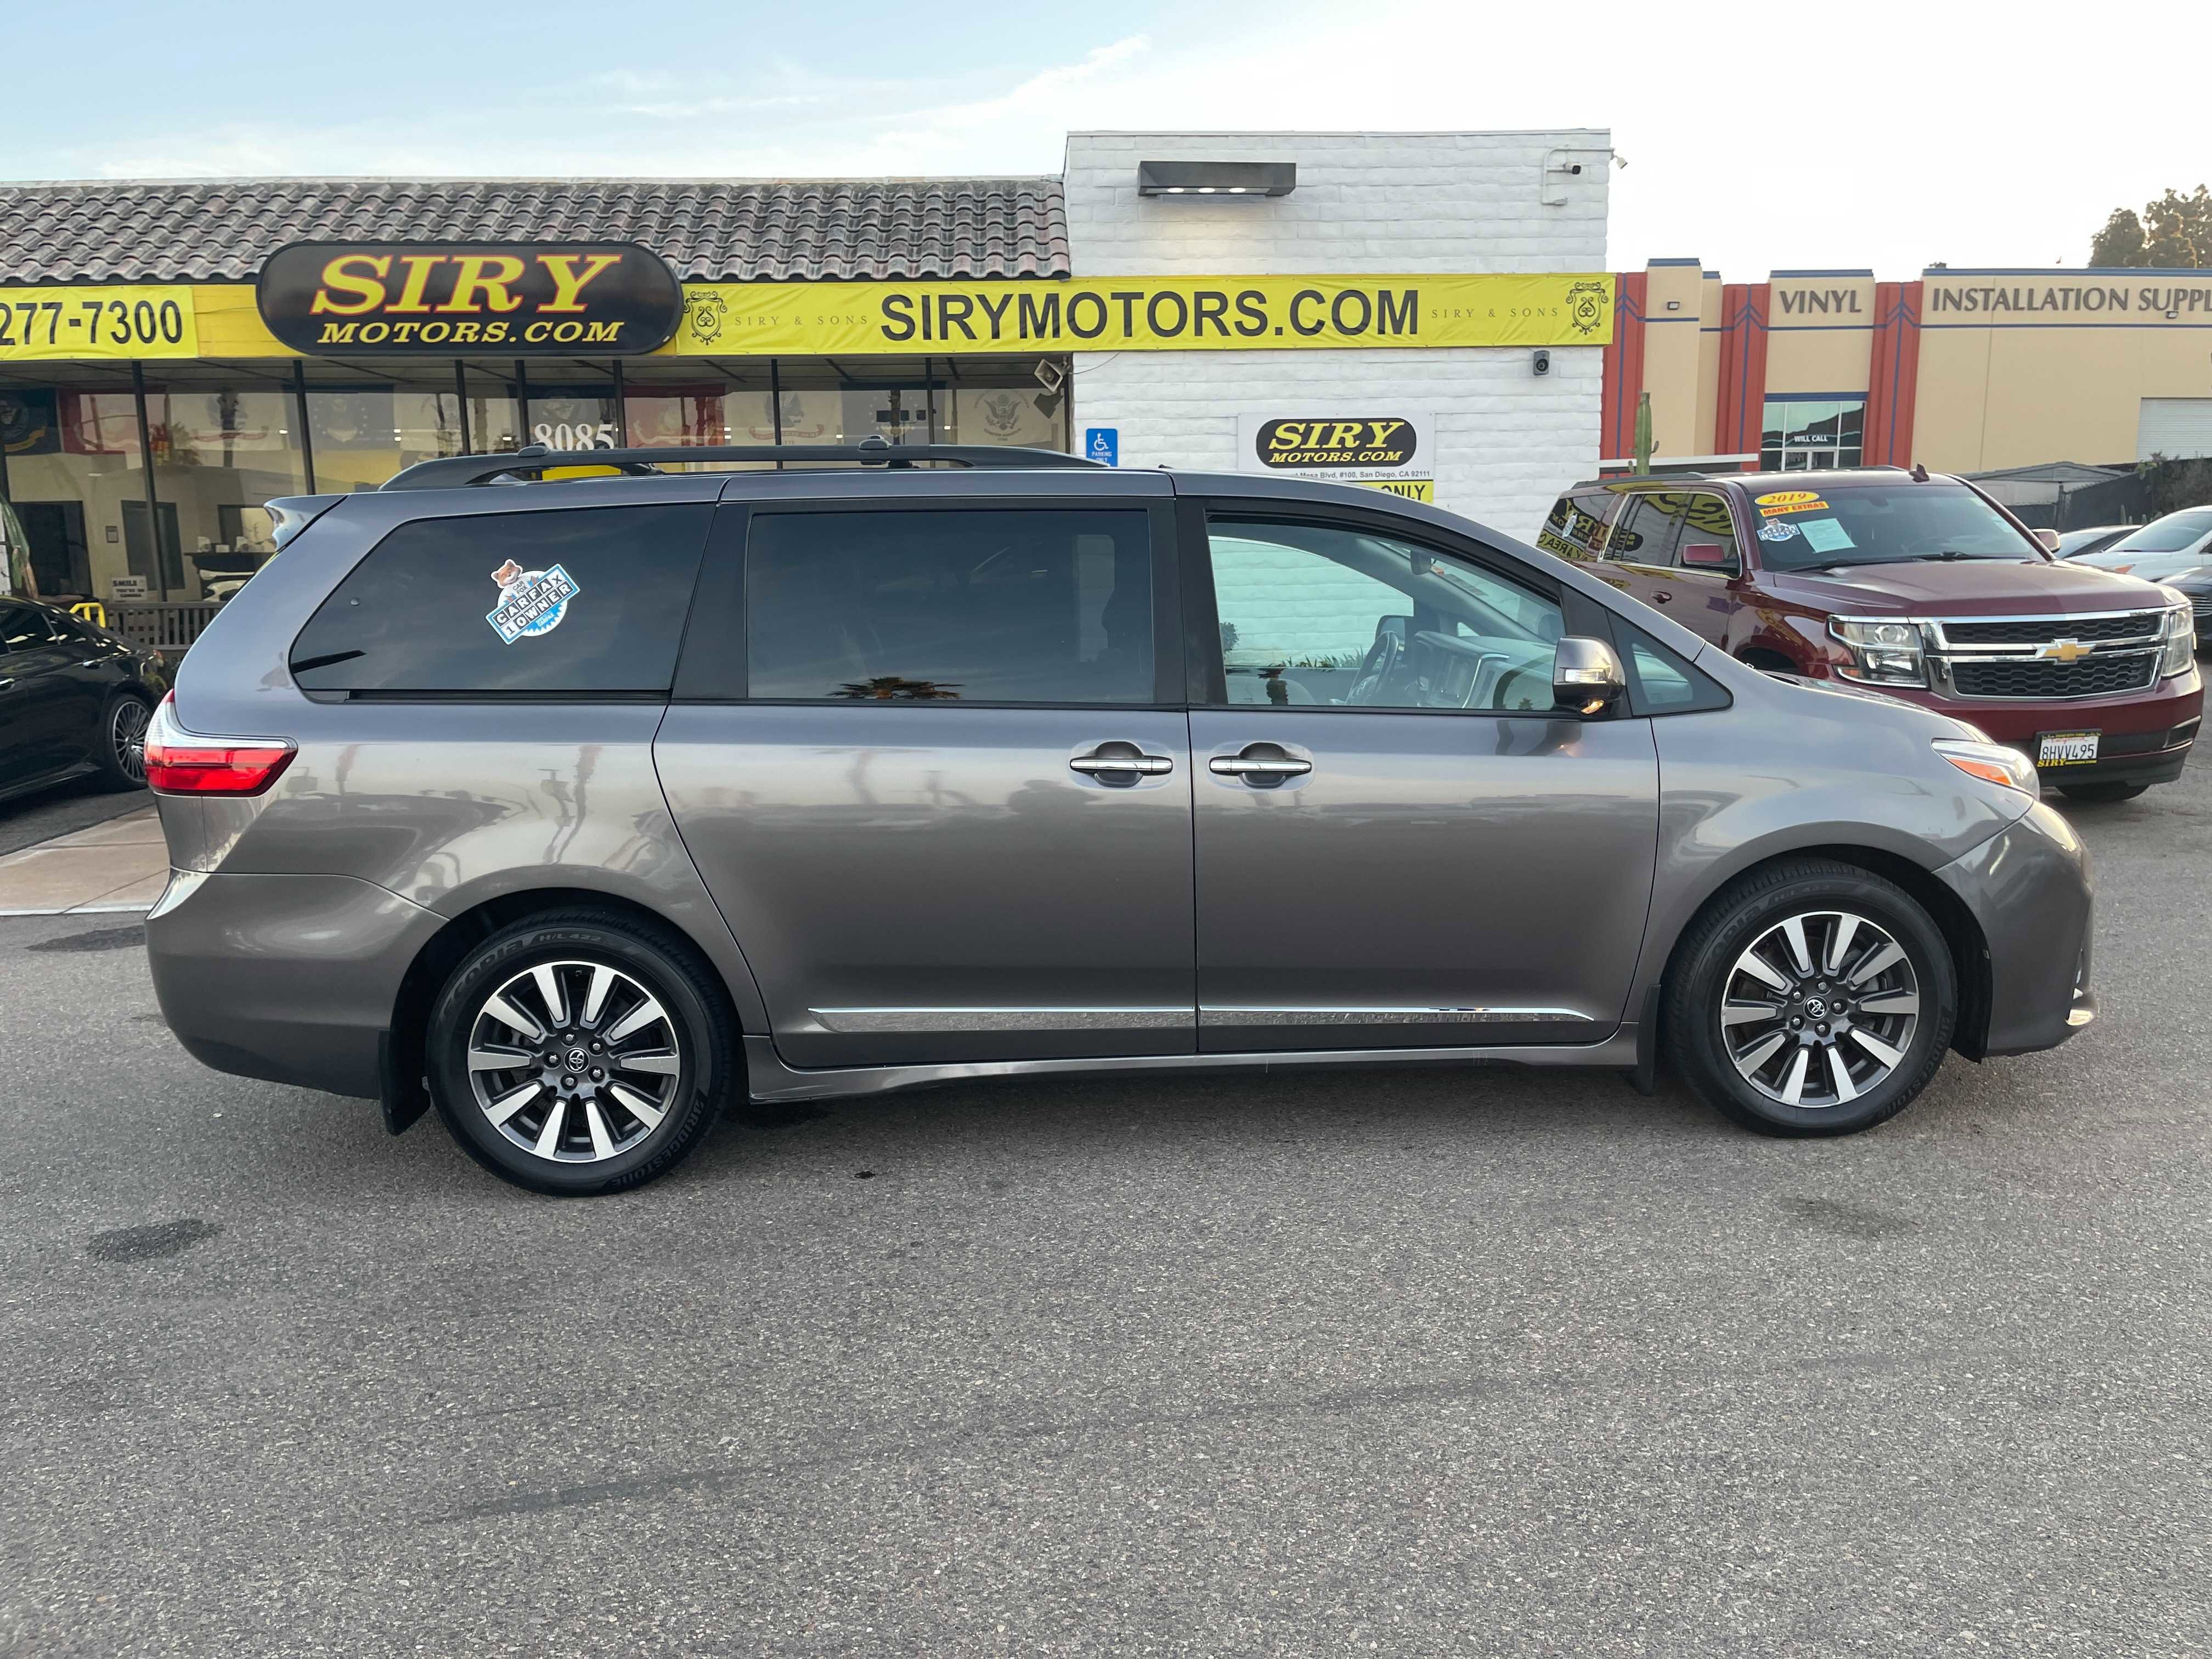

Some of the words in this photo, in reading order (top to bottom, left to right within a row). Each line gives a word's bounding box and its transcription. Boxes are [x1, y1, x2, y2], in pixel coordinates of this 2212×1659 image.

[309, 254, 623, 315] SIRY
[1779, 290, 1862, 313] VINYL
[1932, 288, 2129, 311] INSTALLATION
[2138, 288, 2212, 312] SUPPL
[735, 316, 779, 325] SIRY
[795, 316, 802, 325] &
[817, 315, 867, 325] SONS
[880, 289, 1418, 341] SIRYMOTORS.COM
[1431, 309, 1474, 318] SIRY
[1488, 308, 1496, 317] &
[1510, 308, 1558, 317] SONS
[0, 300, 182, 346] 277-7300
[317, 321, 624, 343] MOTORS.COM
[533, 424, 614, 451] 8085
[1268, 421, 1404, 450] SIRY
[1269, 451, 1403, 463] MOTORS.COM
[1767, 493, 1807, 503] 2019
[1764, 506, 1790, 515] MANY
[1792, 502, 1826, 511] EXTRAS
[512, 580, 525, 591] CAR
[516, 585, 528, 595] FOX
[496, 574, 562, 624] CARFAX
[506, 622, 516, 635] 1
[516, 583, 571, 627] OWNER
[2042, 744, 2095, 760] 8HVV495
[2037, 759, 2067, 768] SIRY
[569, 933, 602, 943] 422
